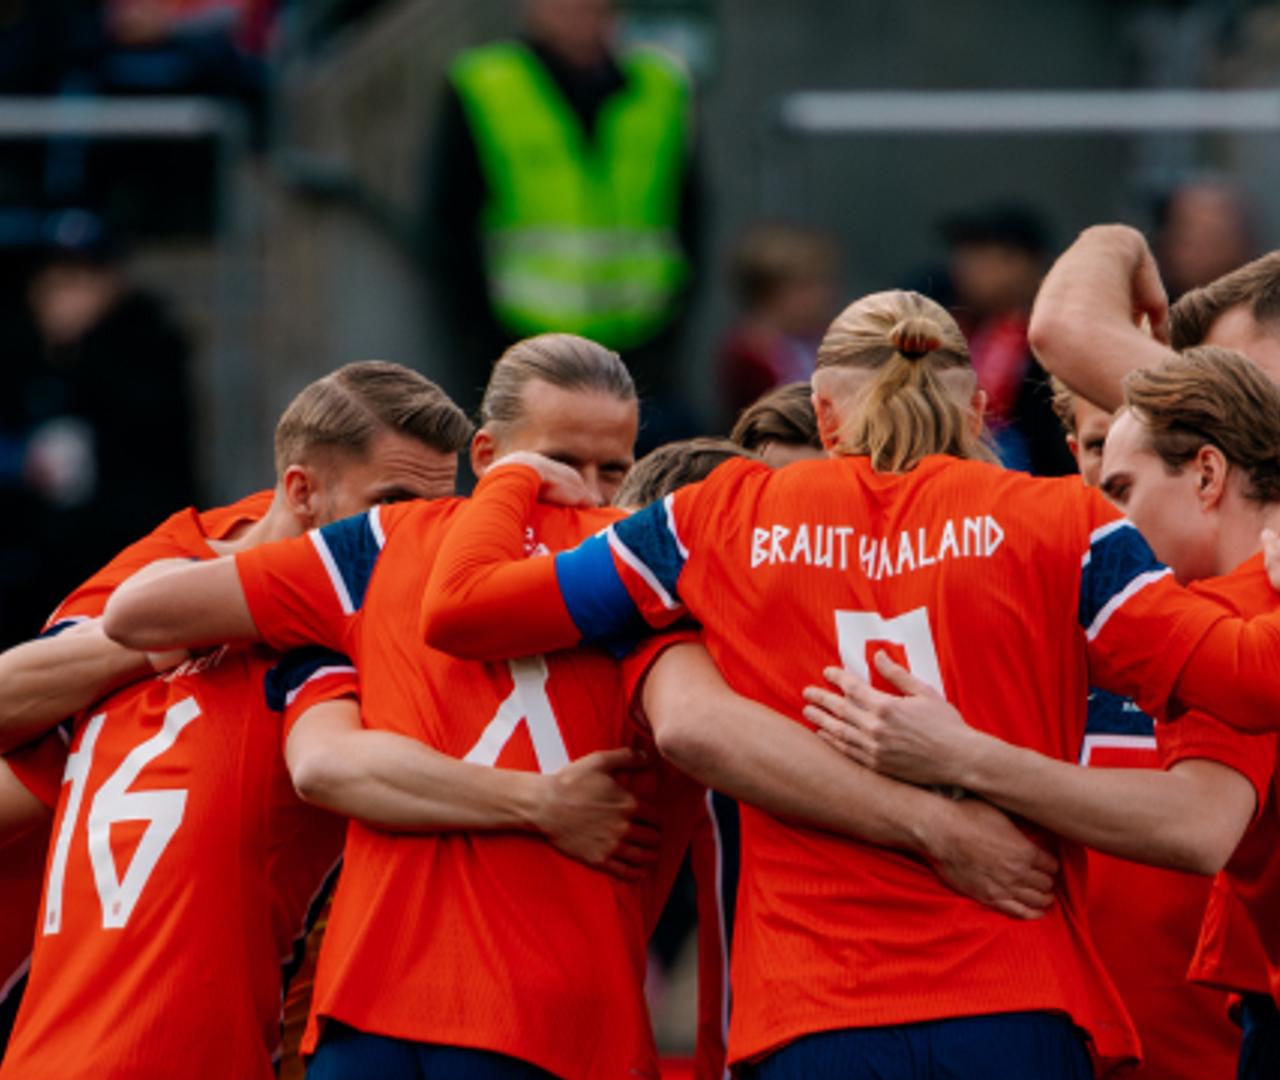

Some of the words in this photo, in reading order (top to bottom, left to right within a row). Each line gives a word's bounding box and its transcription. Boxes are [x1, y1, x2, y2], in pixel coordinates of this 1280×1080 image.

[751, 523, 854, 568] BRAUT
[859, 514, 1004, 580] HAALAND
[42, 695, 202, 936] 16
